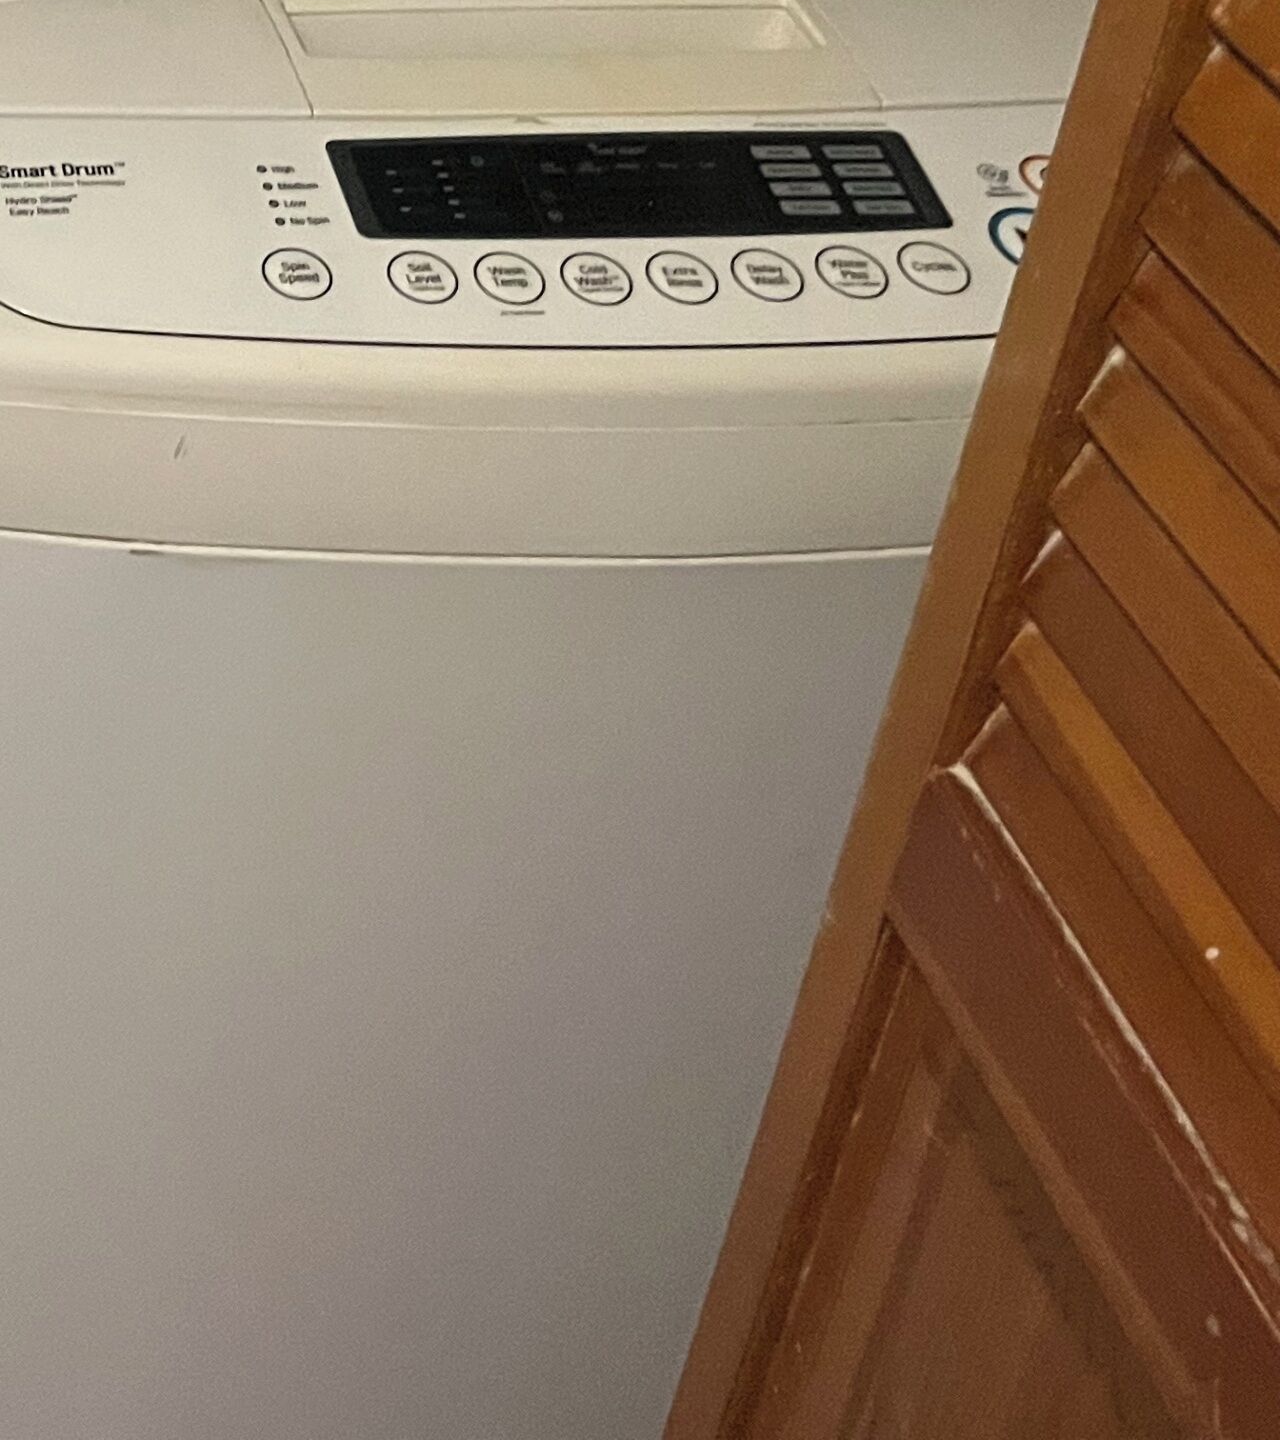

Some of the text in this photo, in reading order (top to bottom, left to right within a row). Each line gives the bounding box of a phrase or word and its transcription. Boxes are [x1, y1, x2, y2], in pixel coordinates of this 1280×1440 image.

[281, 261, 309, 271] Spin
[278, 272, 320, 285] Speed
[406, 273, 442, 283] Level
